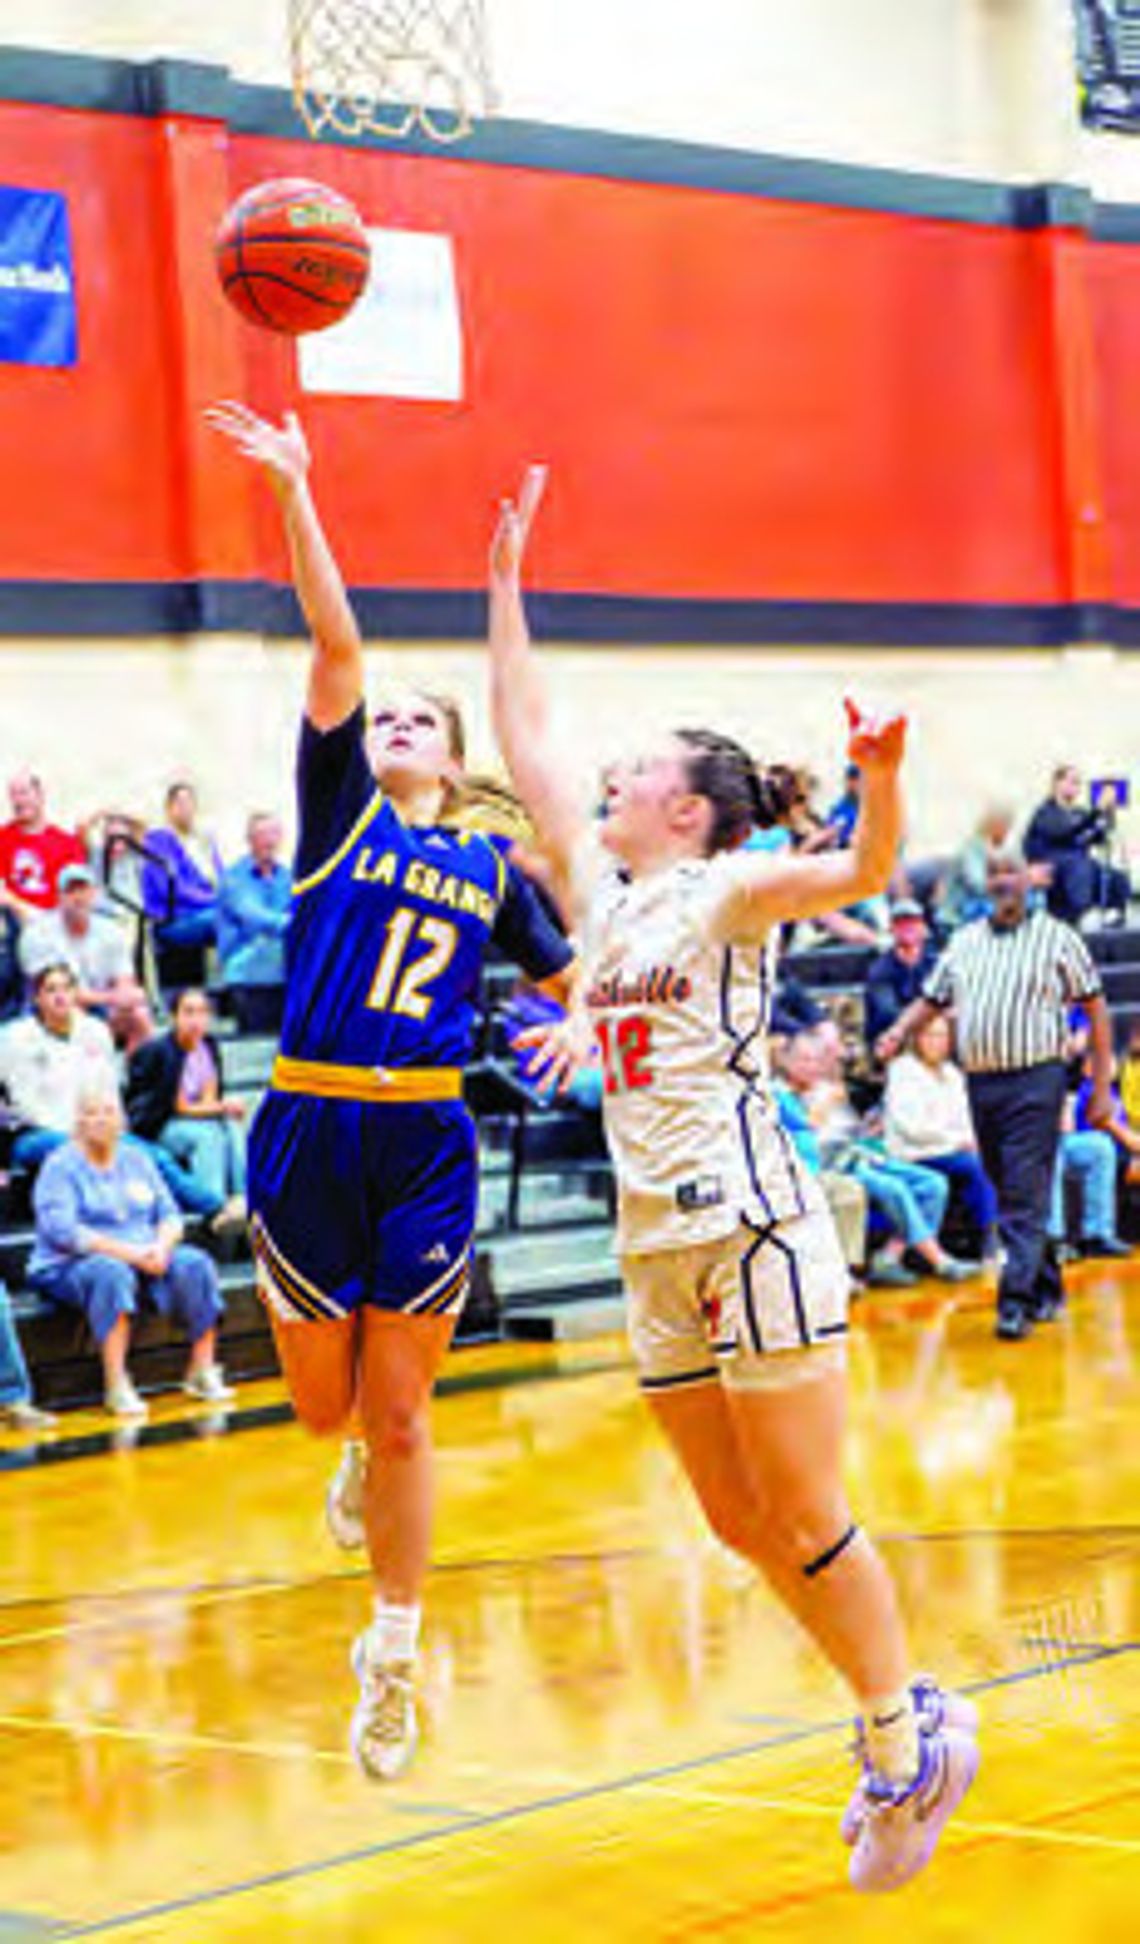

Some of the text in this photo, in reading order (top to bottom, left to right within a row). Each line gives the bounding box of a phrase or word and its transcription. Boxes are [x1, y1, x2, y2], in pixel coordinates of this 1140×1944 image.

[352, 847, 398, 886] LA
[365, 906, 460, 1022] 12
[596, 1014, 655, 1097] 12
